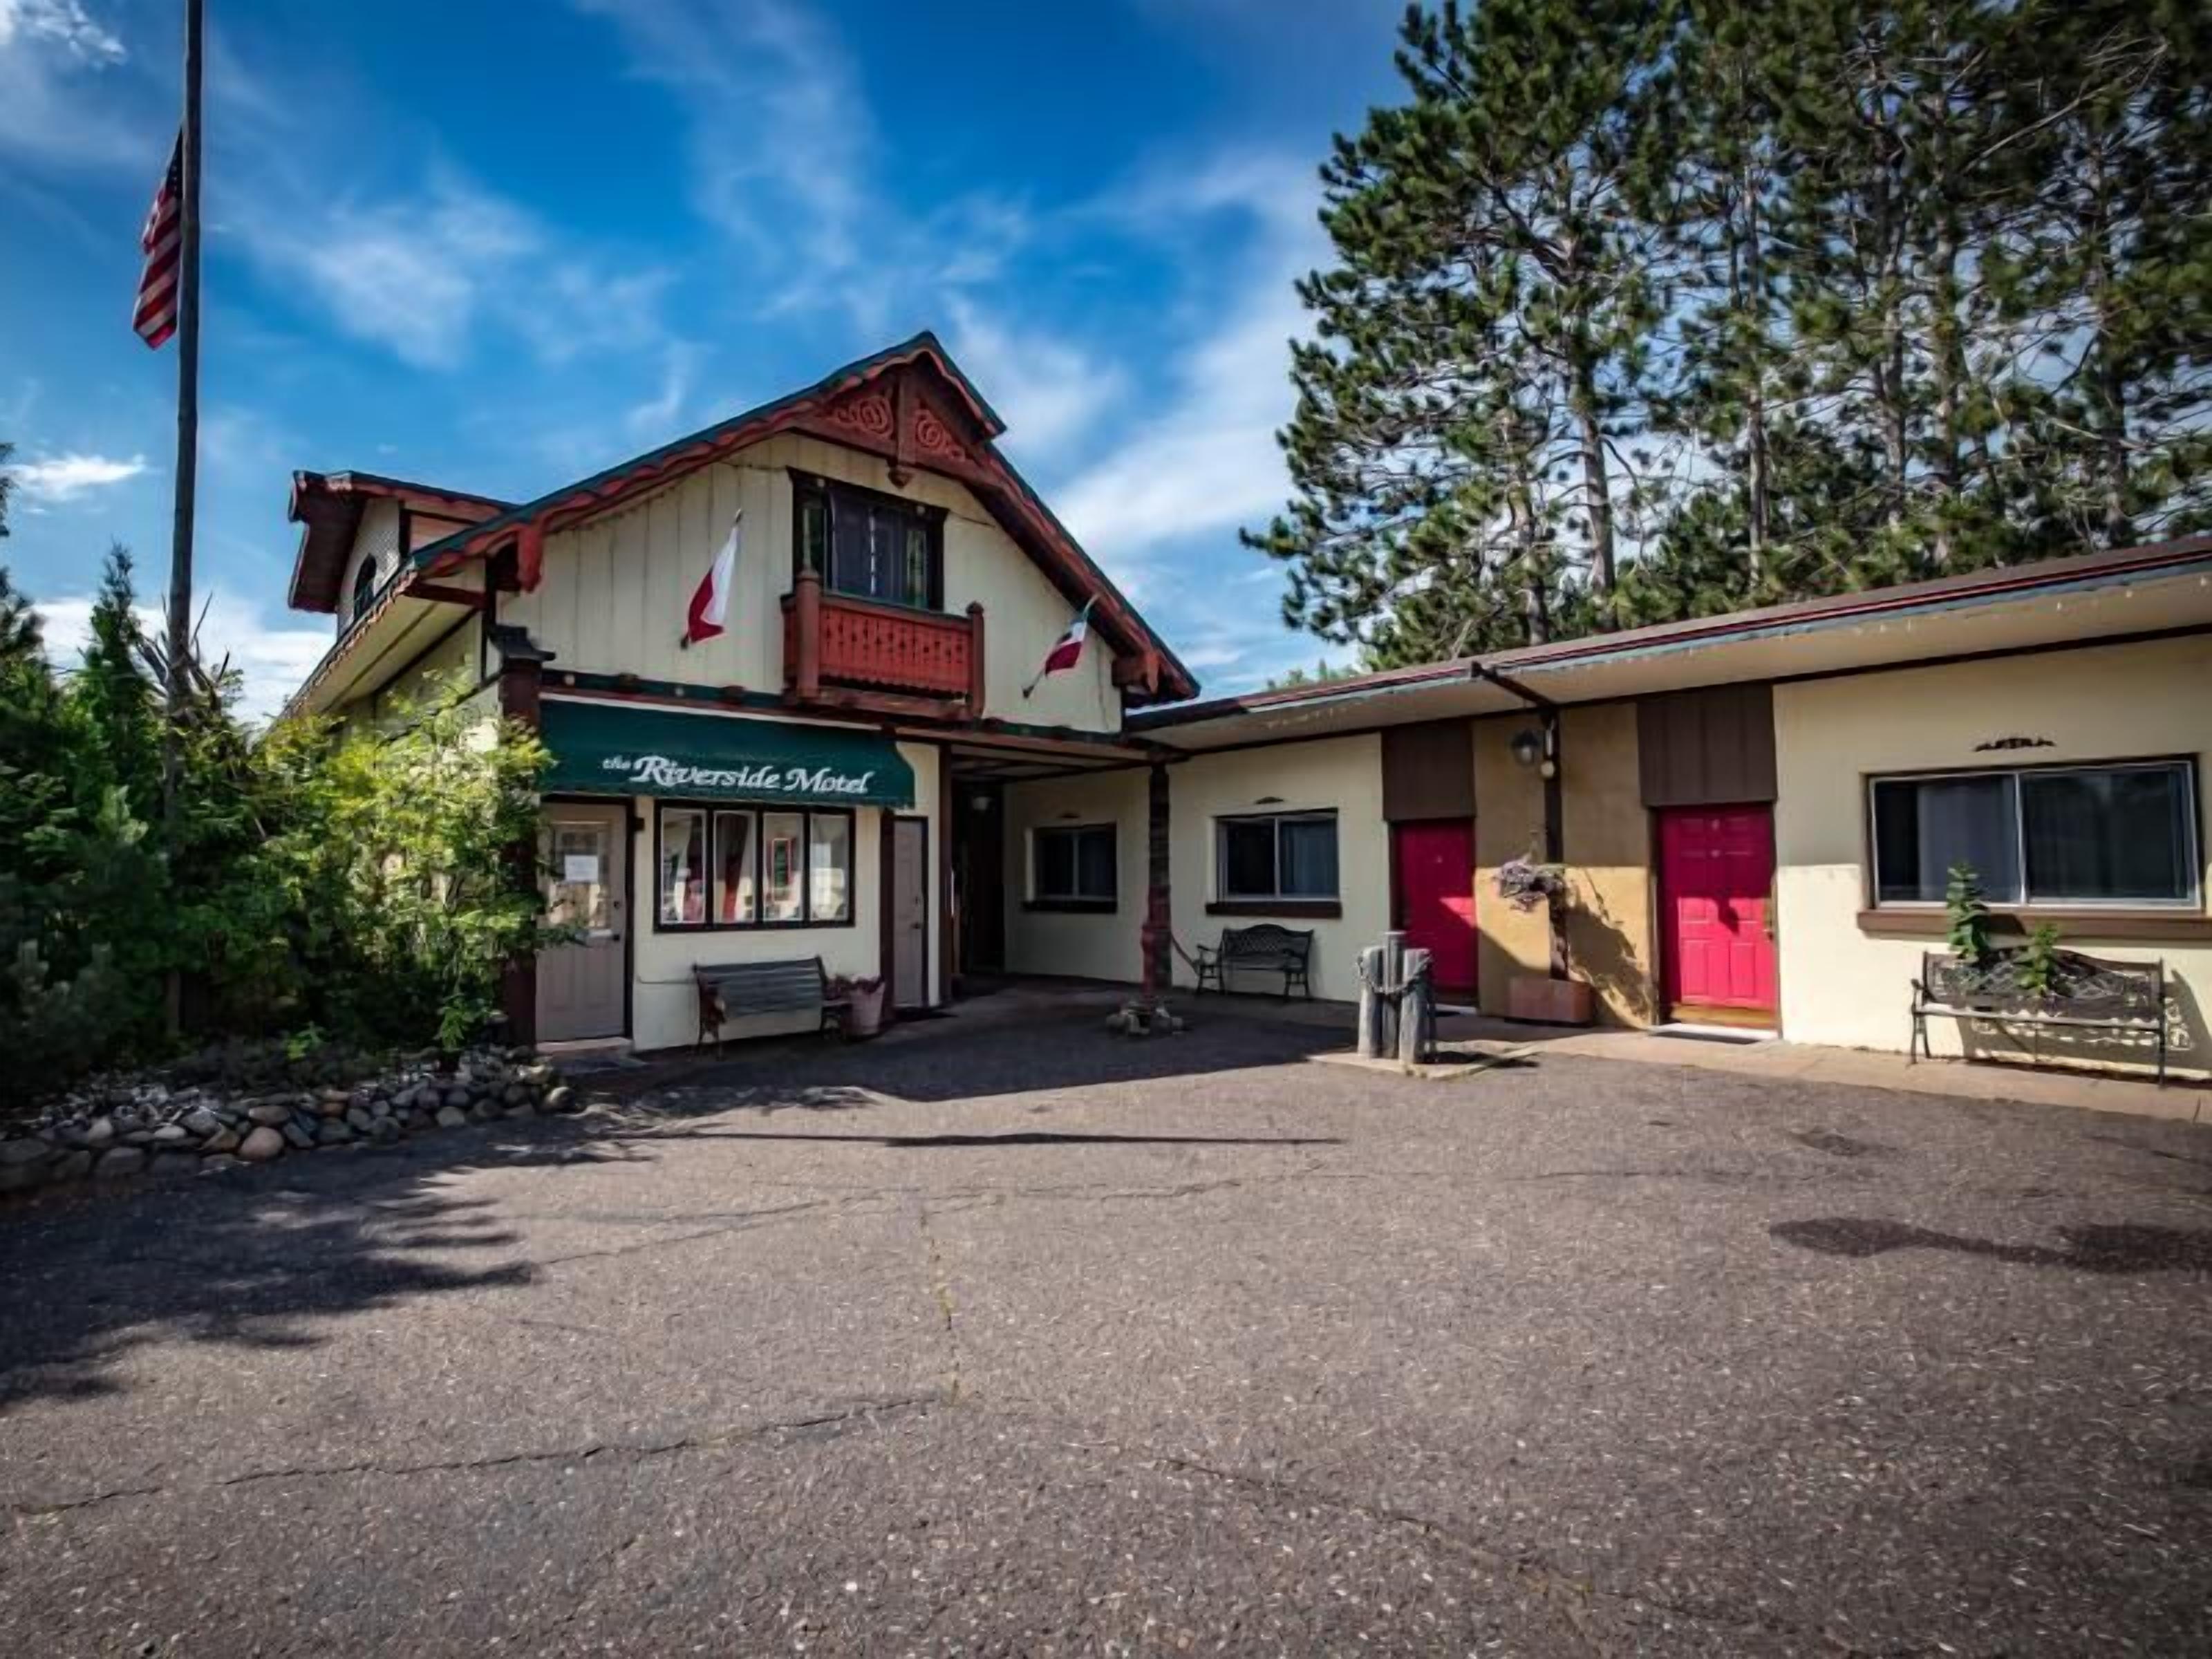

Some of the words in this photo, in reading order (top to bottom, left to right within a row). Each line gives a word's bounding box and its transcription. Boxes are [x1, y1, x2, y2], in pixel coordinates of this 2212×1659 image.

[602, 755, 631, 770] the
[628, 755, 782, 789] Riverside
[782, 767, 875, 795] Motel
